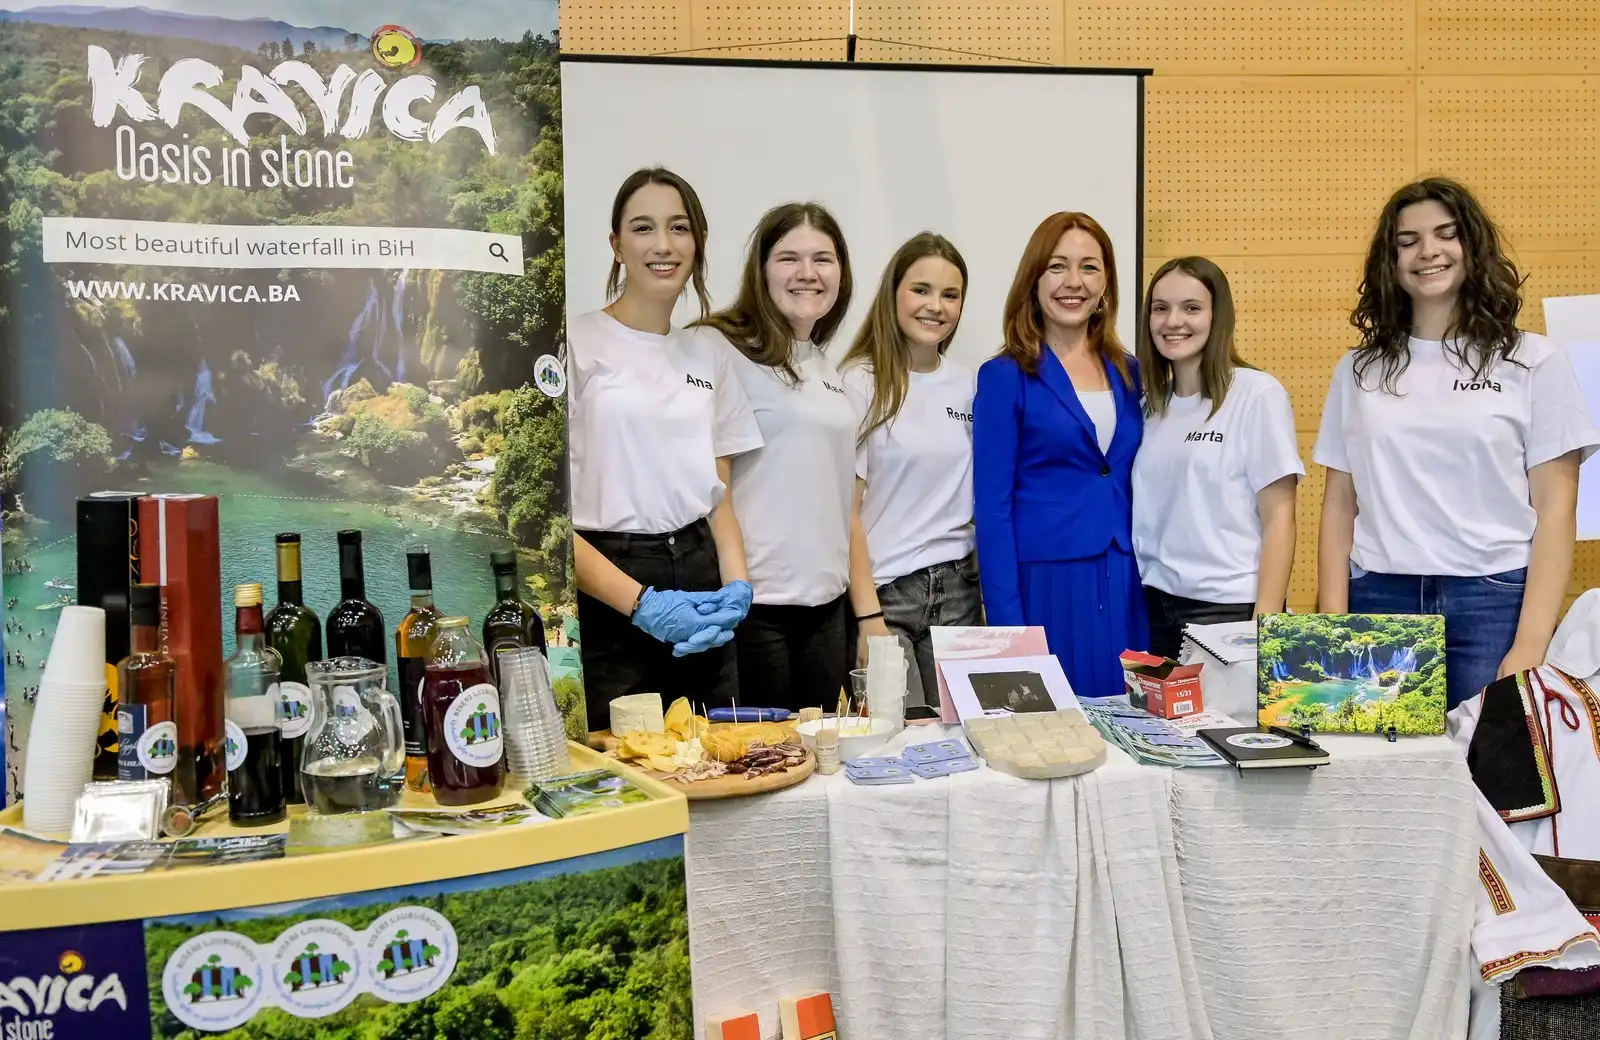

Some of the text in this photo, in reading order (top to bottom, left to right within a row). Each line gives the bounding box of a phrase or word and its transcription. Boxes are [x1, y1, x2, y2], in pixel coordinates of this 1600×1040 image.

[88, 44, 498, 155] KRAVICA
[115, 125, 354, 188] Oasis in stone
[66, 231, 415, 257] Most beautiful waterfall in BiH
[68, 279, 301, 303] WWW.KRAVICA.BA
[686, 373, 714, 390] Ana
[1453, 379, 1502, 393] Ivona
[1184, 430, 1224, 443] Marta
[1175, 689, 1192, 698] 15/33
[0, 972, 127, 1016] AVICA
[5, 1014, 54, 1040] stone
